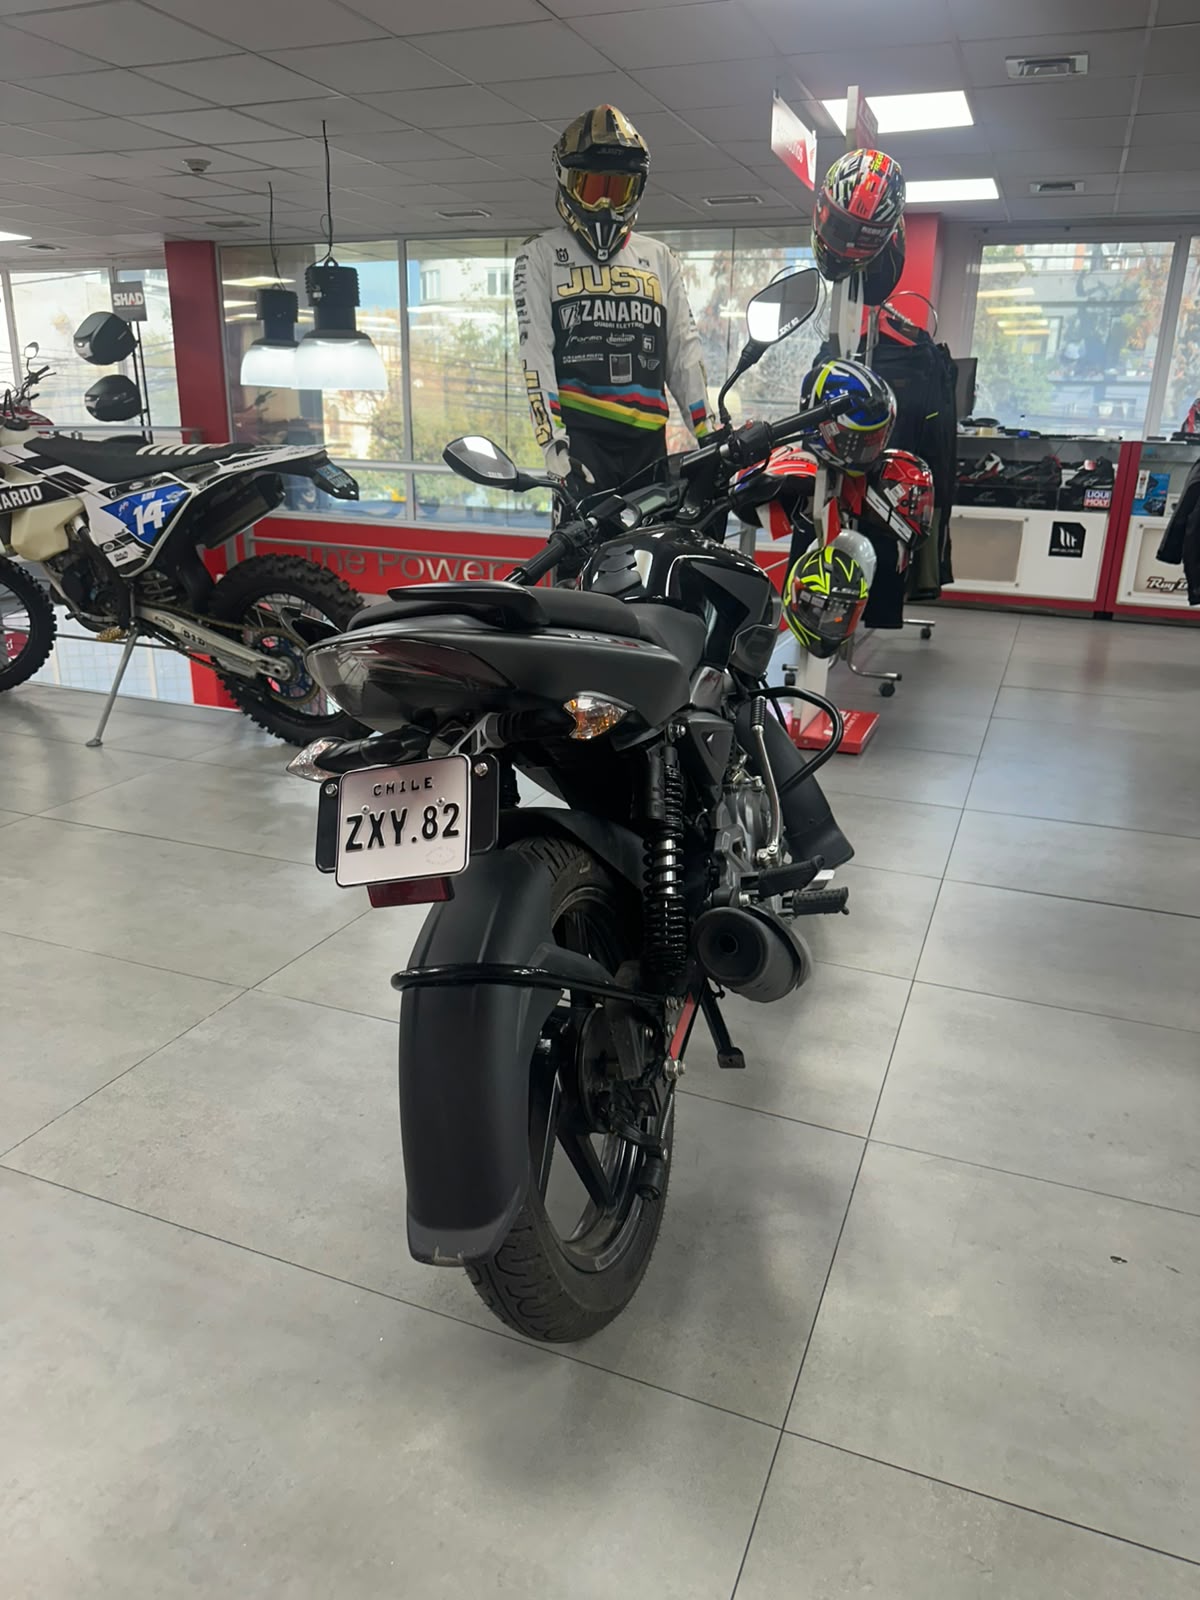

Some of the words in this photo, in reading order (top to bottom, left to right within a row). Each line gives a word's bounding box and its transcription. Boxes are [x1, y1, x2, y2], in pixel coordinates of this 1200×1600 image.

[112, 291, 145, 306] SHAD
[556, 264, 663, 304] JUST1
[581, 299, 661, 328] ZANARDO
[1084, 499, 1110, 508] MOLY
[1086, 490, 1112, 499] LIQUI
[132, 499, 166, 537] 14
[376, 549, 504, 583] Power
[373, 776, 434, 797] CHILE
[345, 803, 460, 852] ZXY.82
